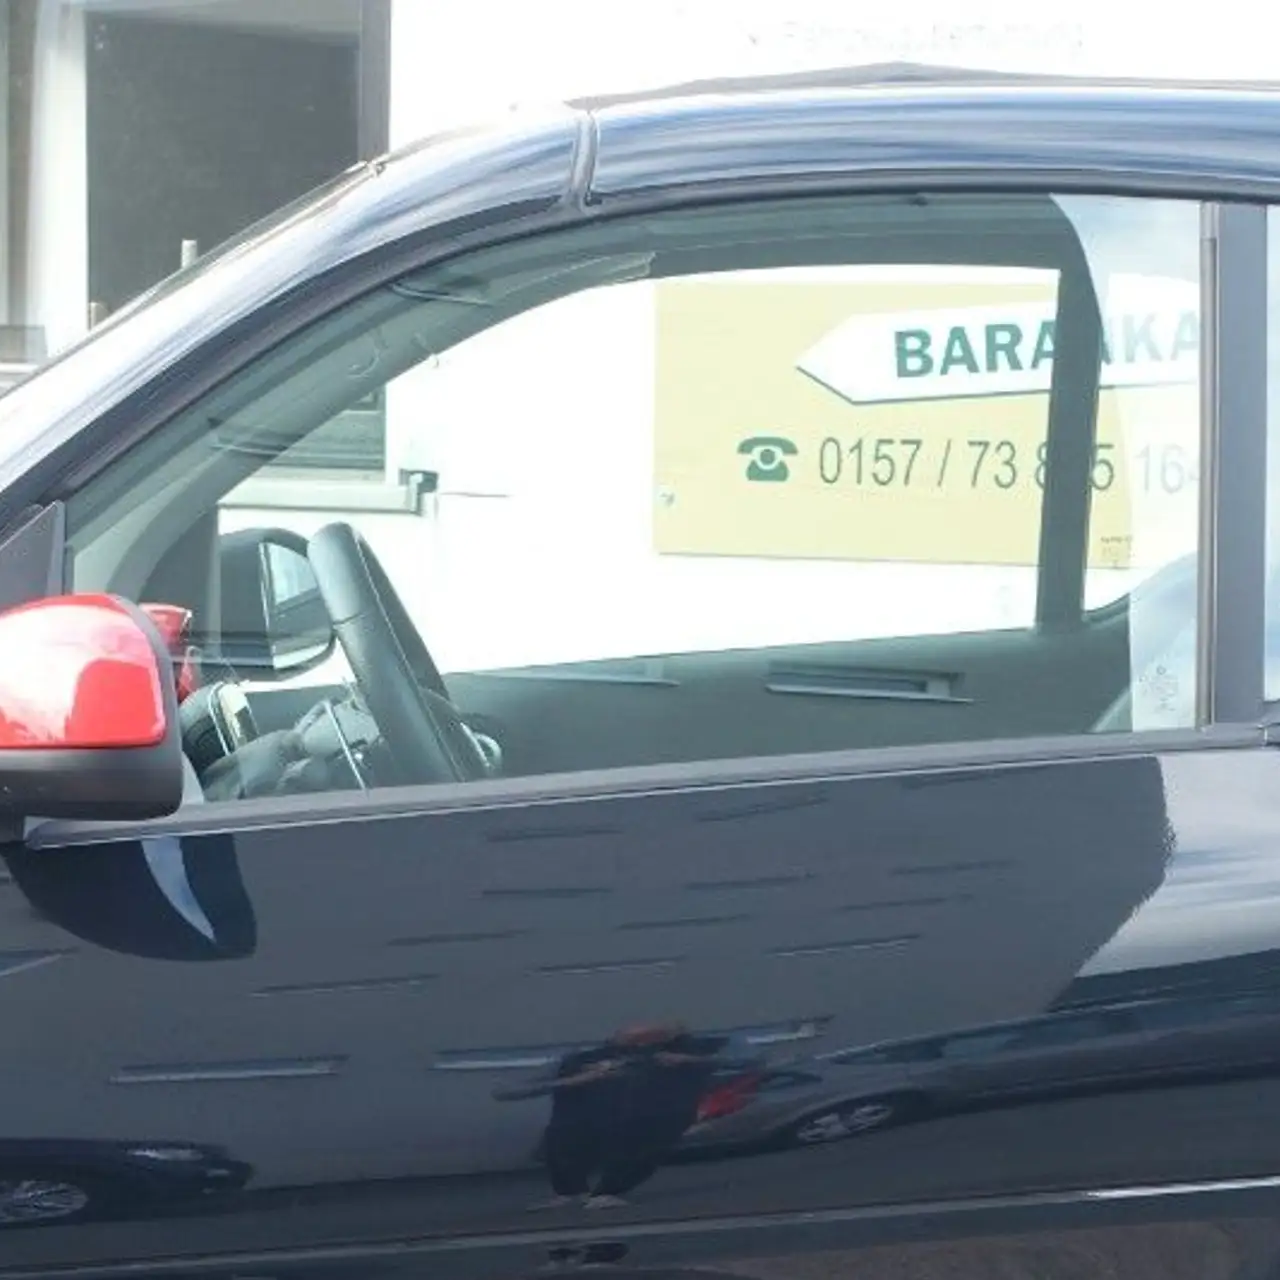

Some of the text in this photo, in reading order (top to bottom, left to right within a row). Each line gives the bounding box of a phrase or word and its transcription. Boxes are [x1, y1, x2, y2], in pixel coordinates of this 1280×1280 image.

[894, 310, 1199, 378] BARAKA
[819, 437, 923, 487] 0157
[968, 440, 1018, 490] 73
[1034, 440, 1115, 492] 85
